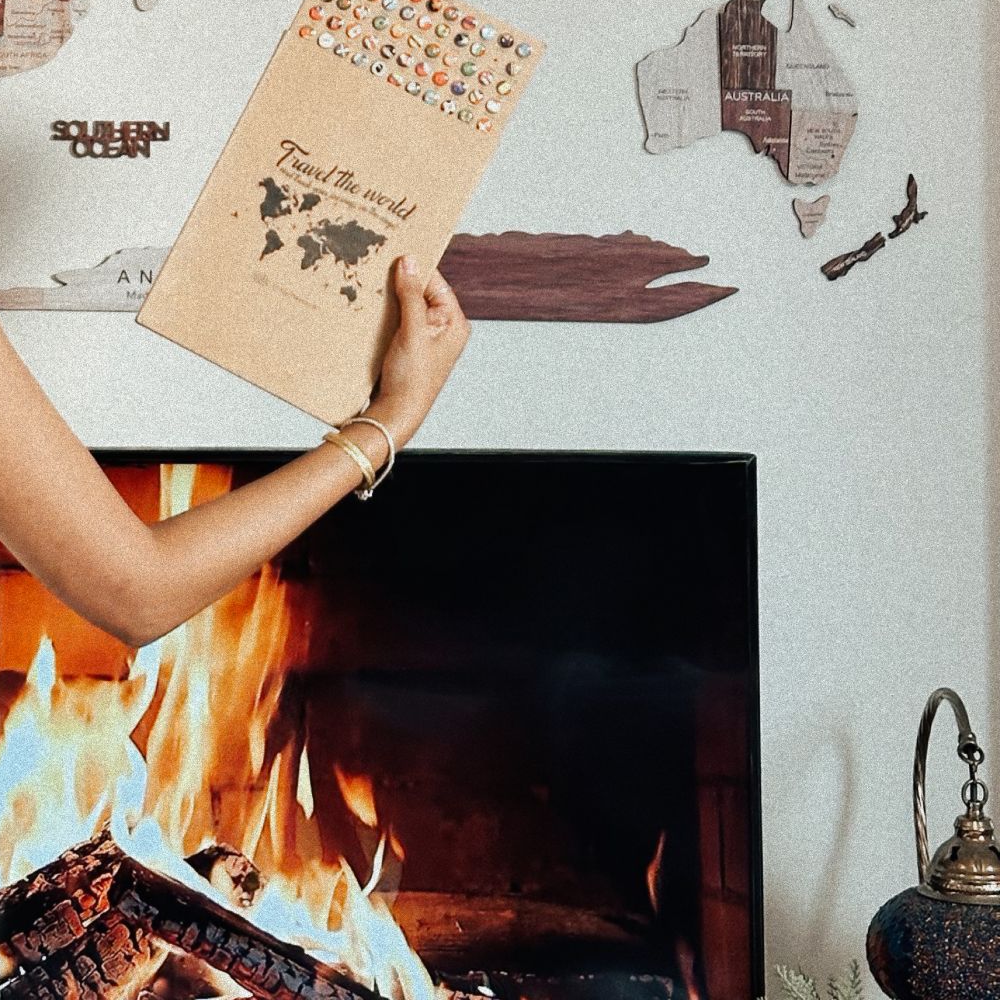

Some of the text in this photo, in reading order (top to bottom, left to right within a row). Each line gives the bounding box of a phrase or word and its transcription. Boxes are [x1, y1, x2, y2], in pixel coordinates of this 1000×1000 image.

[724, 91, 790, 102] AUSTRALIA
[71, 139, 151, 158] OCEAN
[276, 139, 339, 183] Travel
[334, 169, 361, 194] the
[363, 188, 418, 221] world
